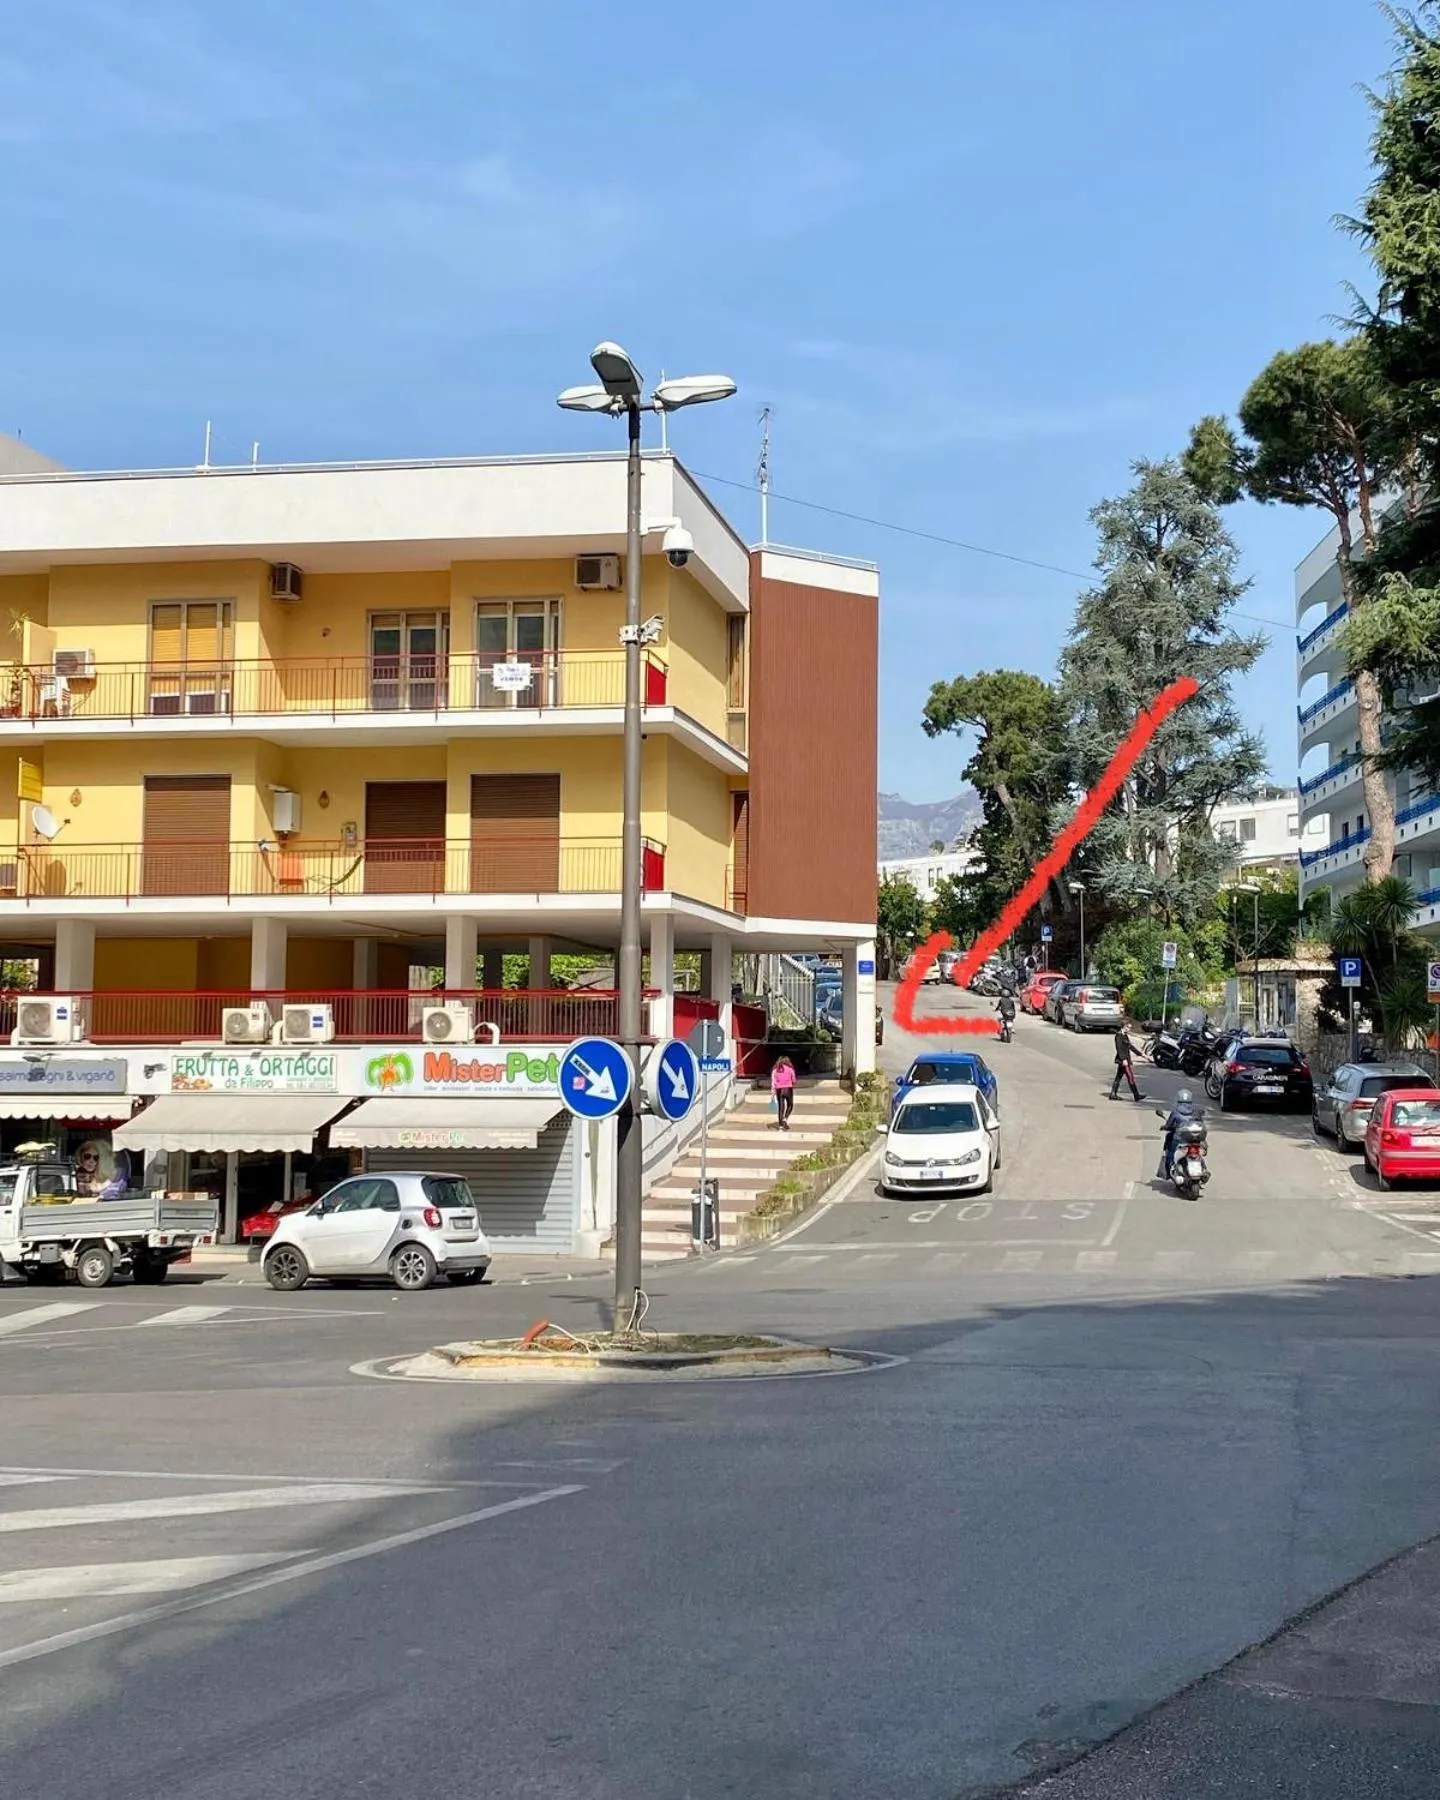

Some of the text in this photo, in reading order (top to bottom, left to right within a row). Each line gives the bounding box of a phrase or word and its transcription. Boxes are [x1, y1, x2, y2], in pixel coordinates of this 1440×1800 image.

[1345, 961, 1357, 975] P
[176, 1057, 334, 1076] FRUTTA & ORTAGGI
[423, 1051, 561, 1083] MisterPet
[702, 1062, 729, 1071] NAPOLI
[66, 1070, 75, 1082] &
[225, 1078, 237, 1089] da
[240, 1077, 274, 1090] Filippo
[907, 1202, 1096, 1223] STOP
